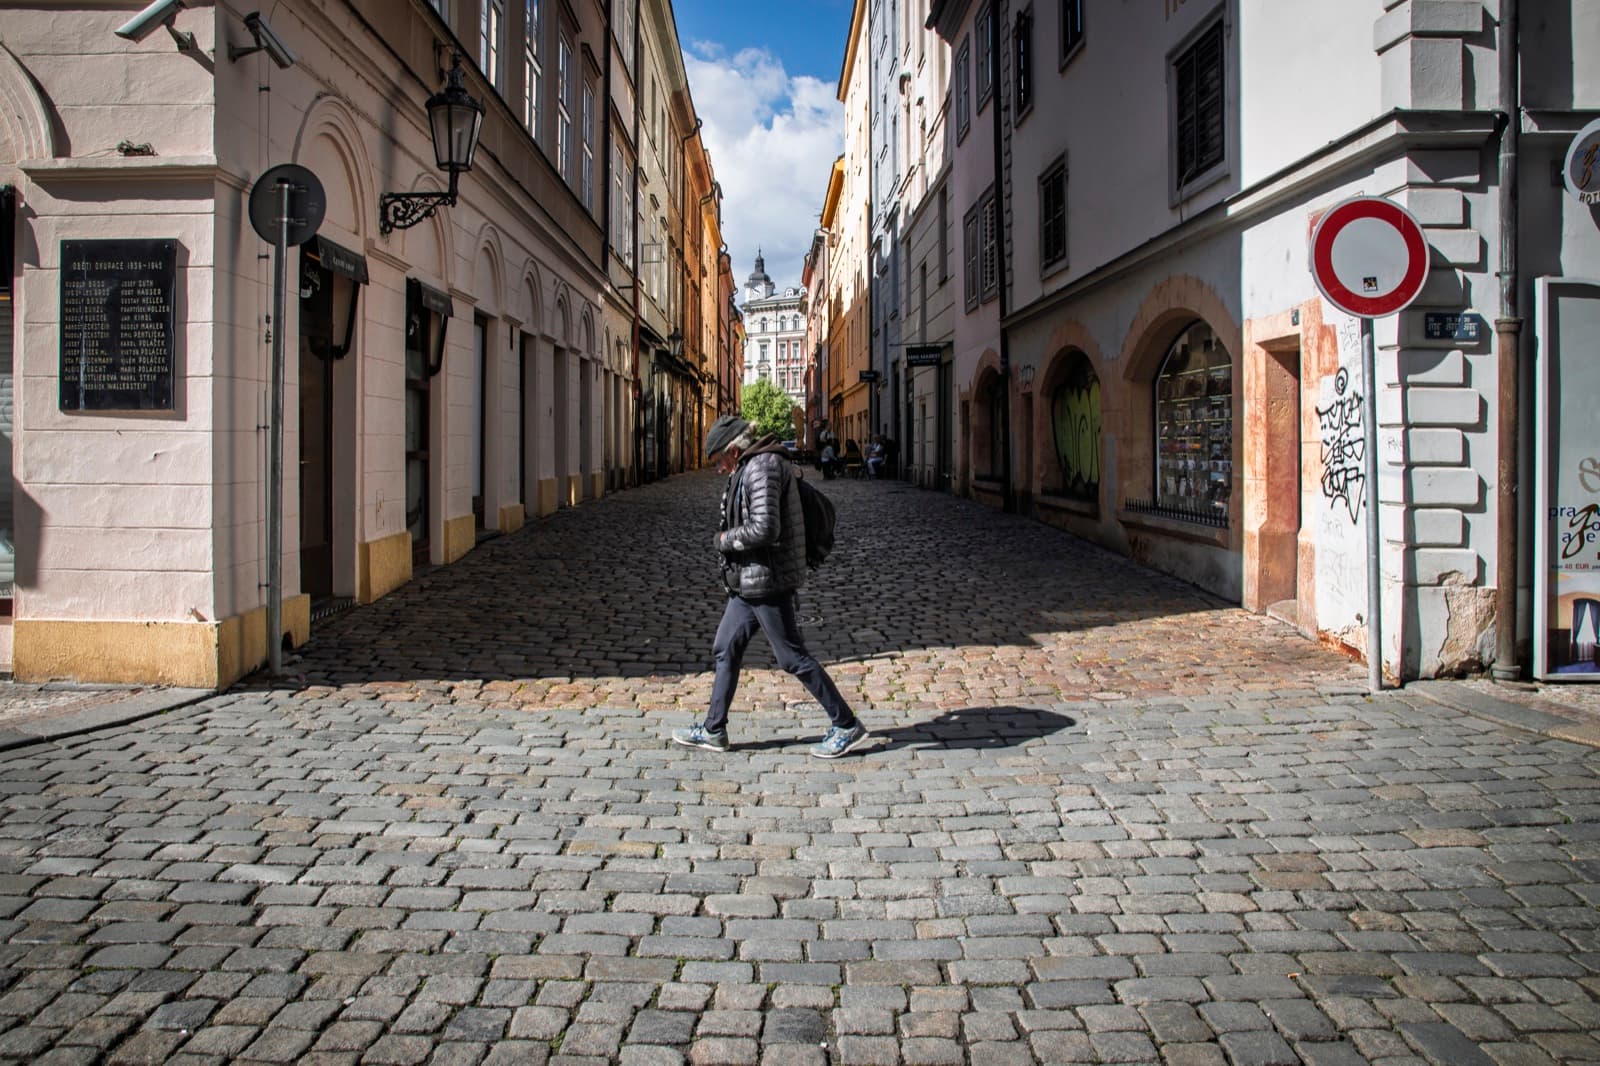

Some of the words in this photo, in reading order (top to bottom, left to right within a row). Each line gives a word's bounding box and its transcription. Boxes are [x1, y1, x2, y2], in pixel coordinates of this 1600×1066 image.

[1579, 191, 1600, 204] HOT
[95, 262, 124, 270] OKUPACE
[1575, 562, 1589, 570] EUR
